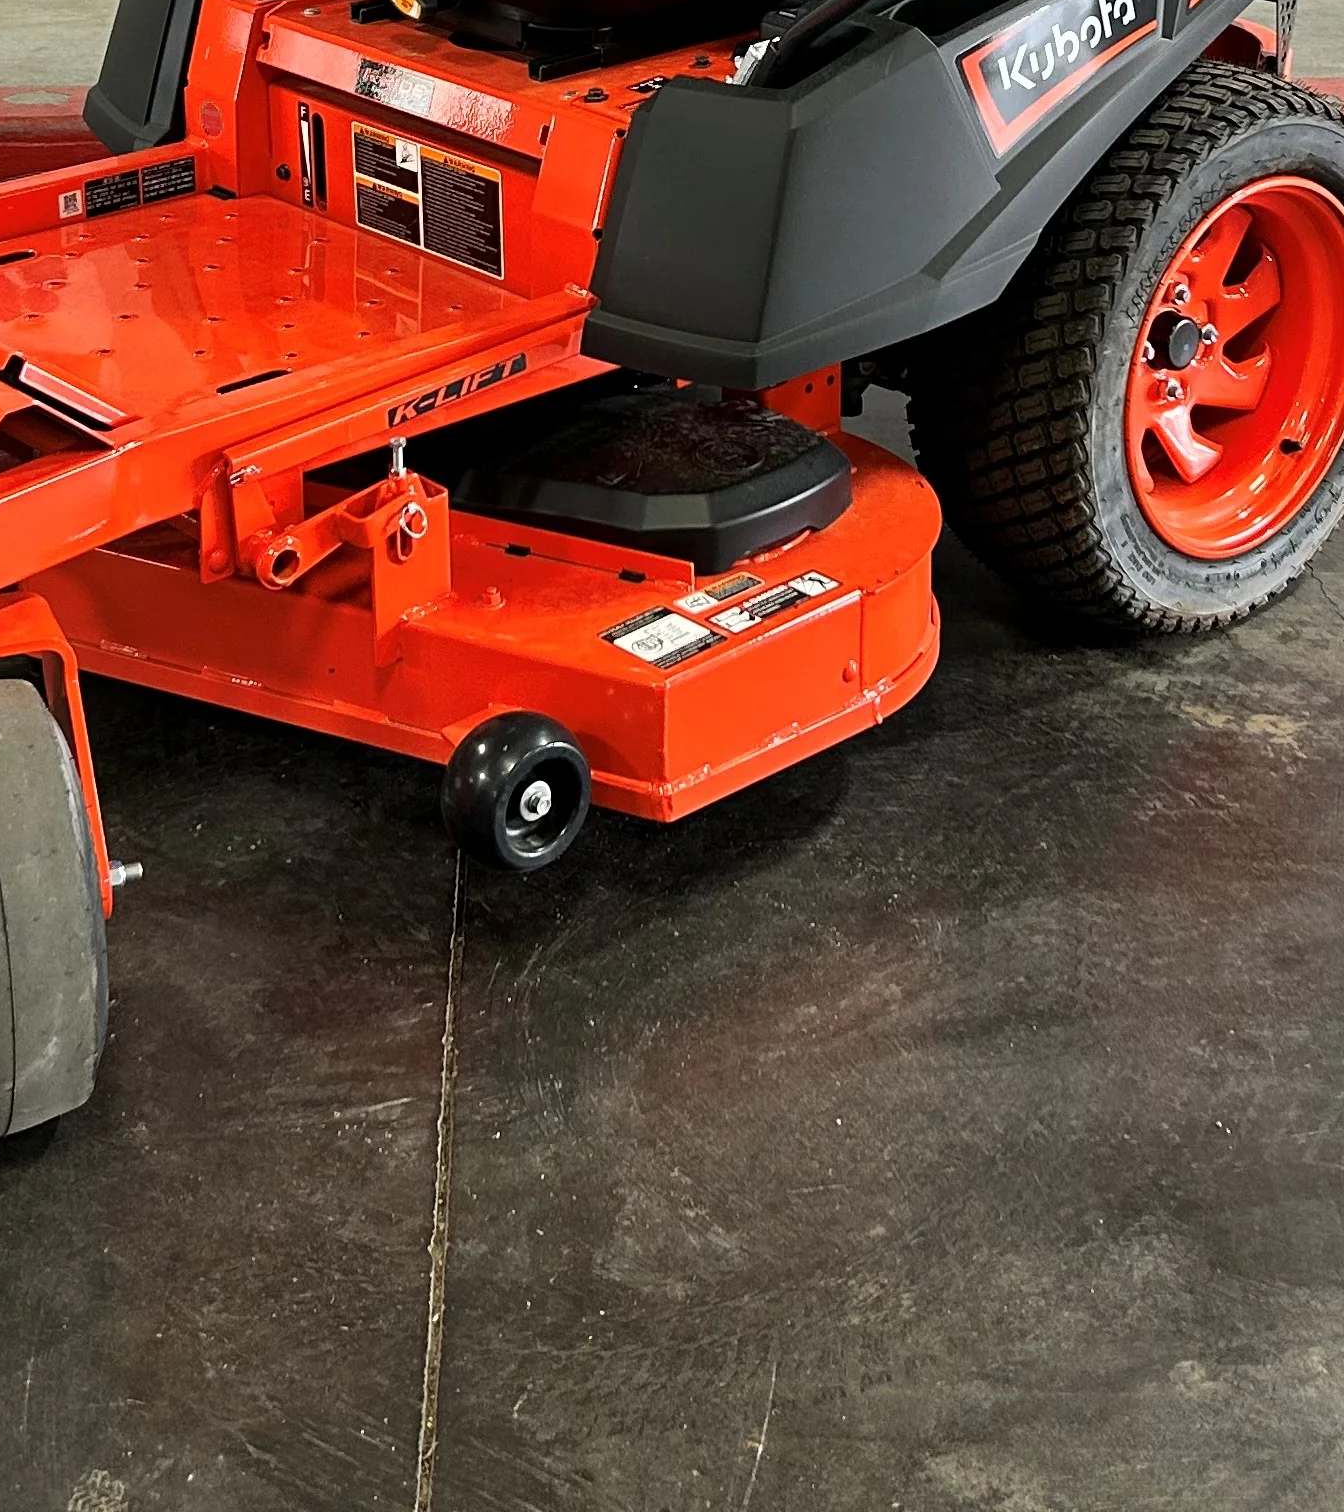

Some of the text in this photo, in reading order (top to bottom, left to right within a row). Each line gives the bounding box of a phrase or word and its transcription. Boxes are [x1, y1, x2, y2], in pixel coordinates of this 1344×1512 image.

[300, 105, 307, 118] F
[304, 188, 311, 202] E
[392, 353, 523, 426] K-LIFT
